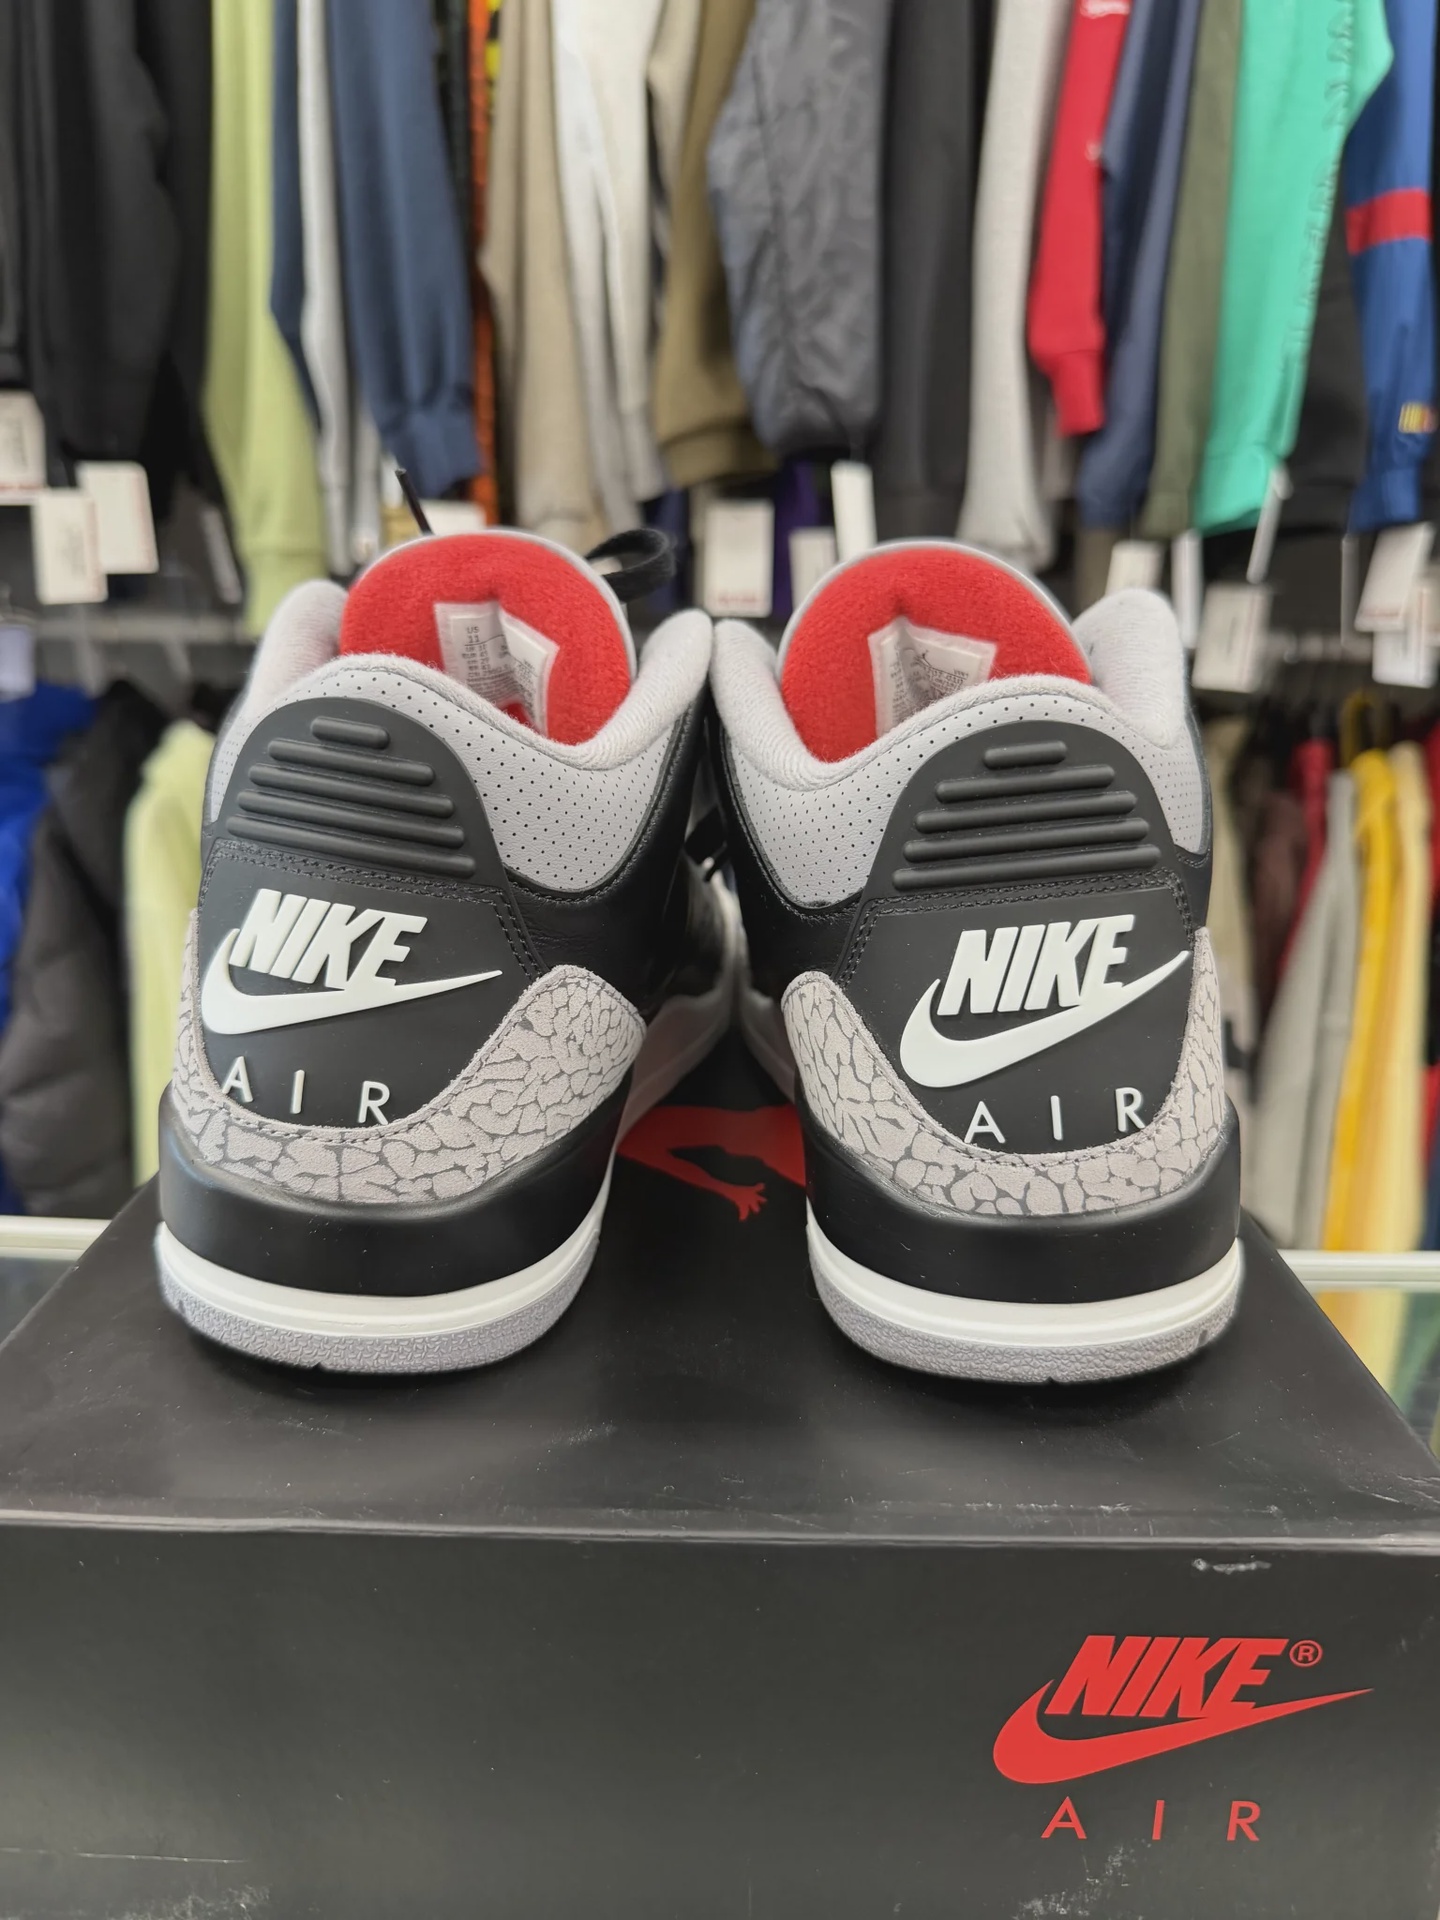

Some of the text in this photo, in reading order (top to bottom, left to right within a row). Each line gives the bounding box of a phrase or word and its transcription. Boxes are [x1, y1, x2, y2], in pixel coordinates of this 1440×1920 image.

[466, 626, 480, 634] US
[228, 888, 428, 990] NIKE
[936, 914, 1135, 1016] NIKE
[222, 1055, 391, 1126] AIR
[964, 1087, 1145, 1144] AIR
[1044, 1635, 1289, 1719] NIKE
[1041, 1796, 1261, 1842] AIR
